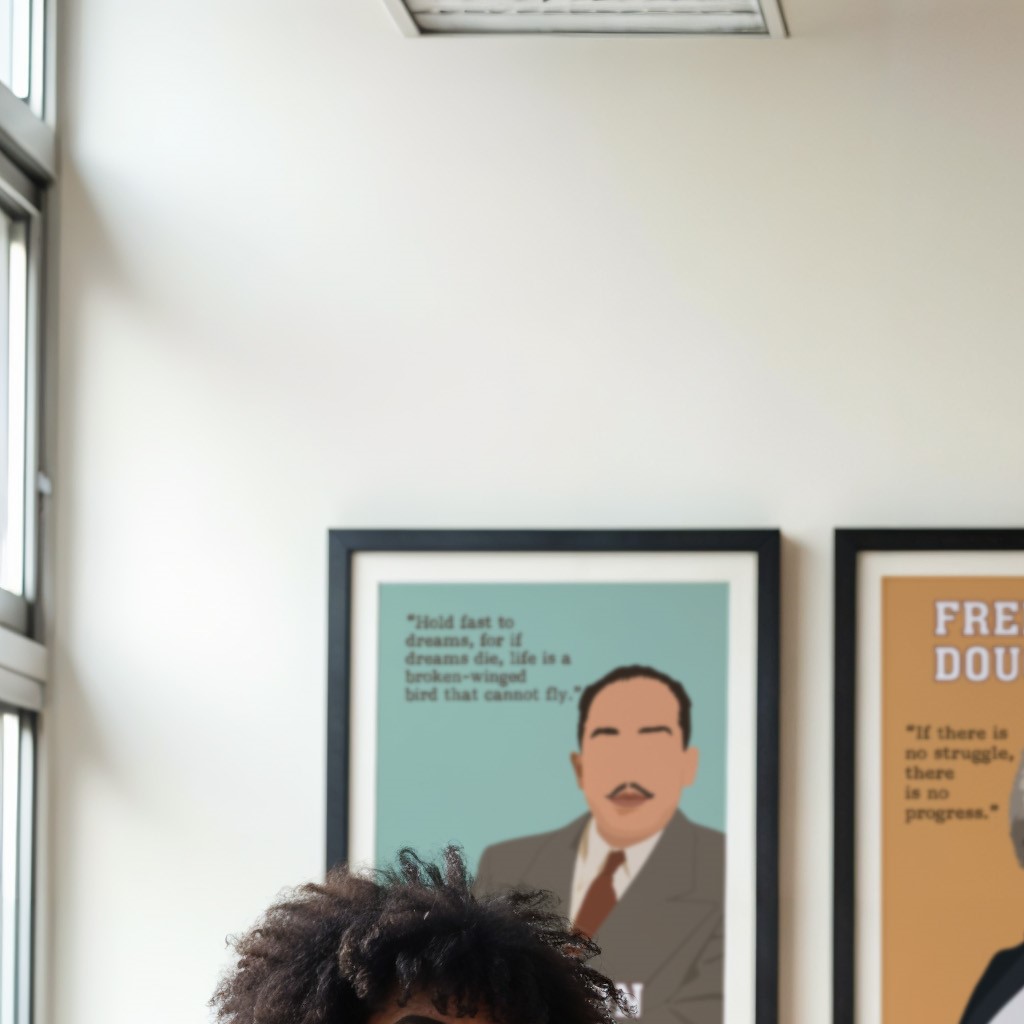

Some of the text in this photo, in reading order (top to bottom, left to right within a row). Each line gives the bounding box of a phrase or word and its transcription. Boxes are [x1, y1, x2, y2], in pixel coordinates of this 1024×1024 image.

[406, 613, 515, 630] "Hold fast to
[404, 632, 523, 649] dreams, for if
[404, 650, 572, 667] dreams die, life is a
[404, 669, 527, 688] broken-winged
[404, 686, 581, 705] bird that cannot fly."
[905, 725, 1009, 741] "If there is
[904, 746, 1015, 765] no struggle,
[904, 766, 955, 781] there
[904, 786, 950, 801] is no
[904, 803, 1000, 824] progress."
